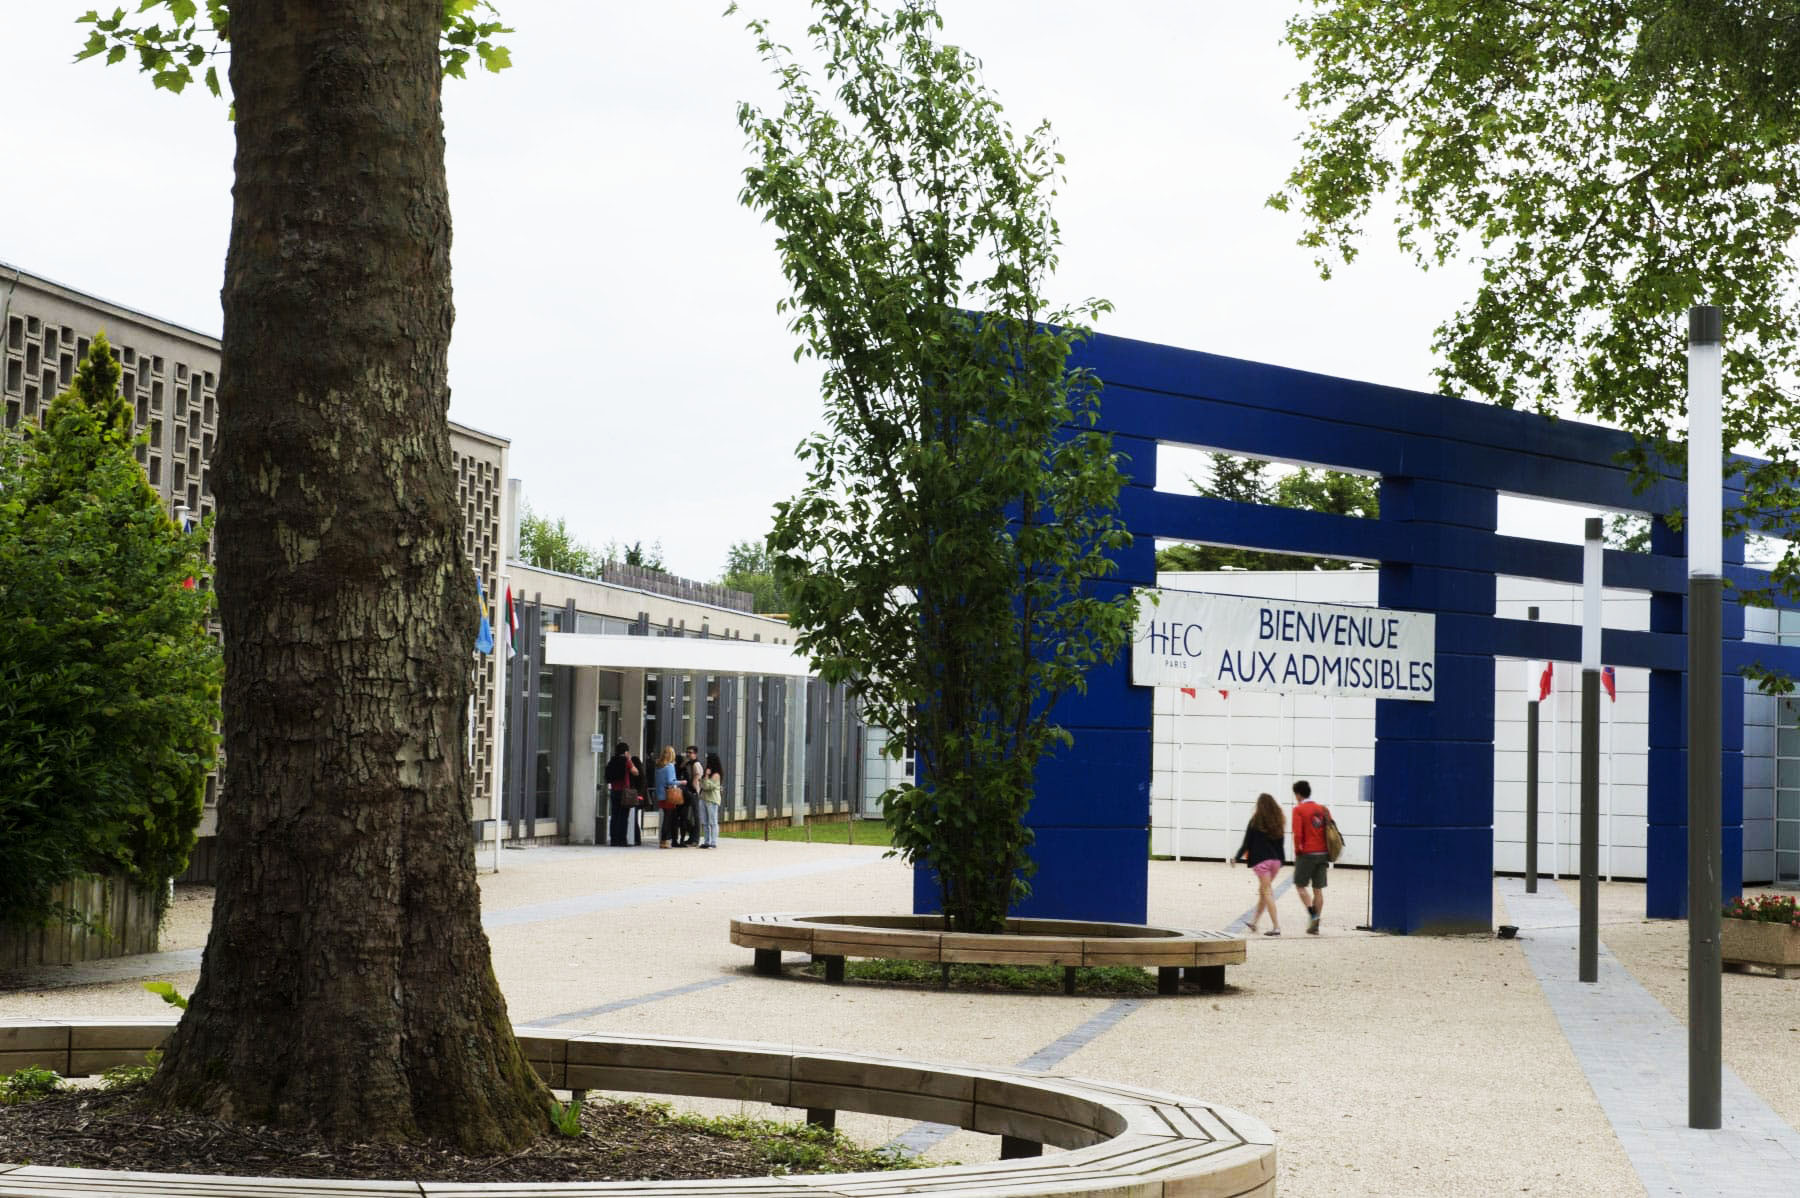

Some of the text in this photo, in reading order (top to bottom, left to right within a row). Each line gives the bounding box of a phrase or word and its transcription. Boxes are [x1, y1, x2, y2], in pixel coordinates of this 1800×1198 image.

[1147, 620, 1202, 658] HEC
[1259, 608, 1399, 649] BIENVENUE
[1164, 659, 1187, 669] PARIS
[1217, 649, 1433, 692] AUX ADMISSIBLES
